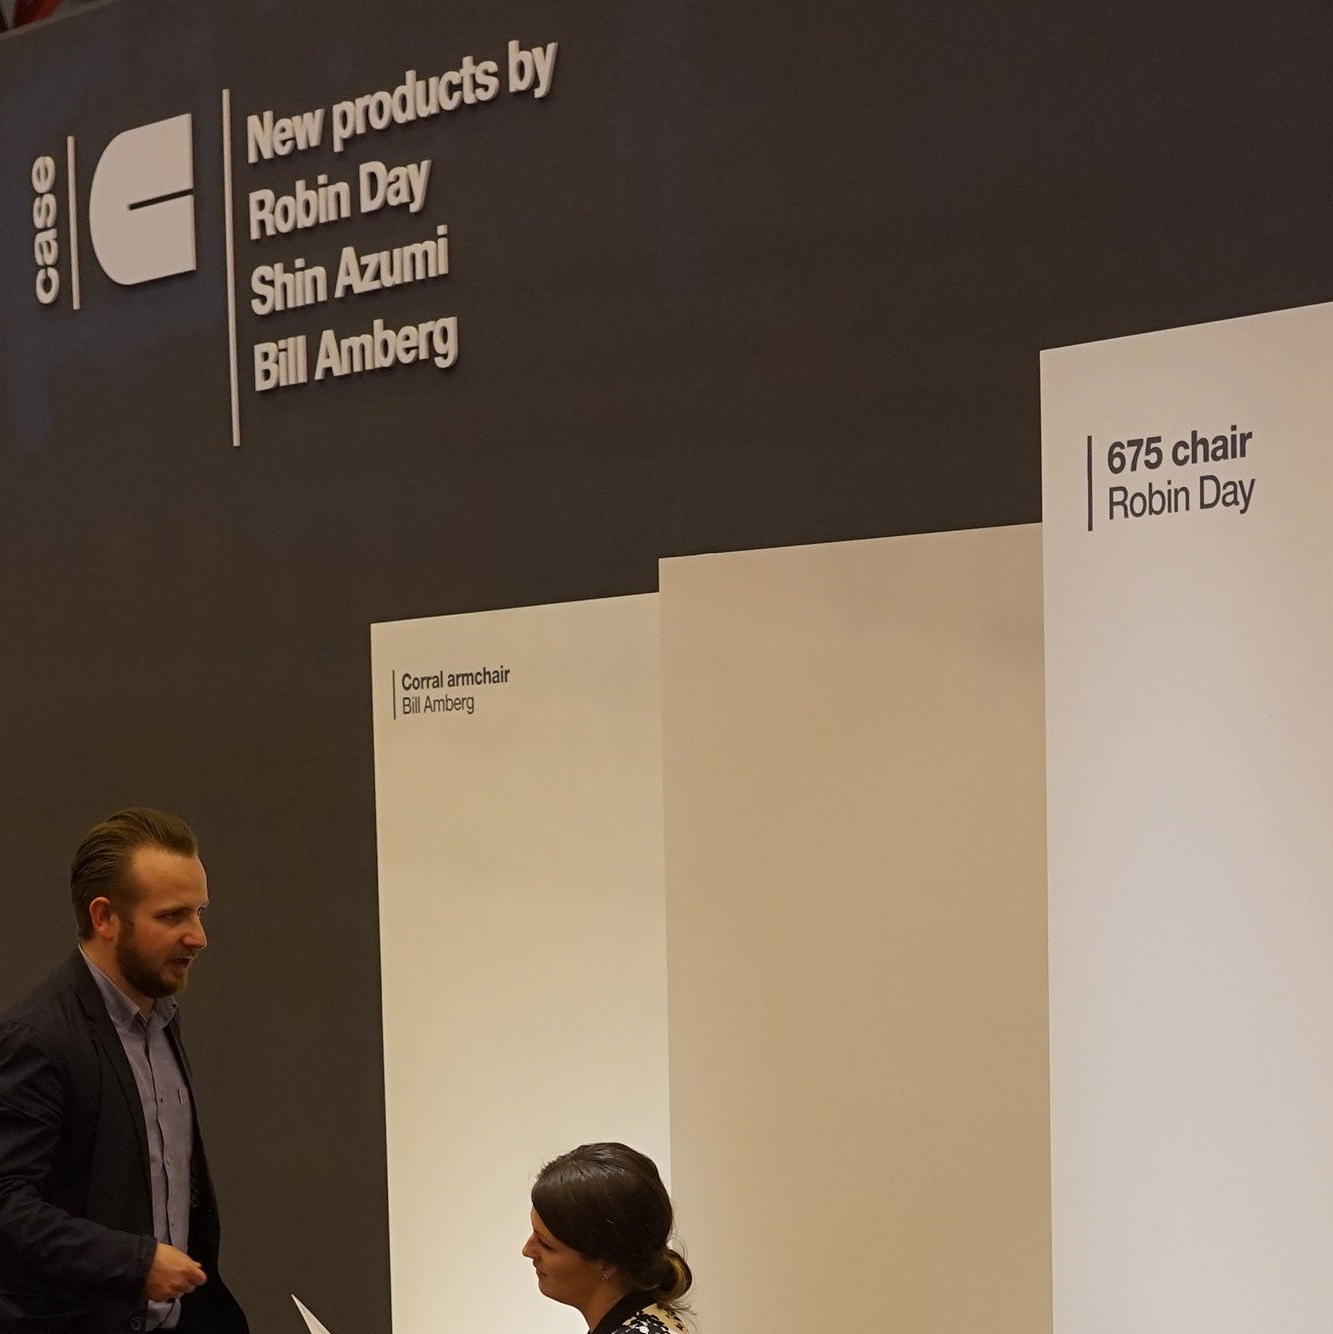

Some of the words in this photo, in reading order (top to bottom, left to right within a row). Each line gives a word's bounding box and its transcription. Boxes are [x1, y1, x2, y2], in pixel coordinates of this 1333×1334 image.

[247, 107, 324, 164] New
[332, 55, 499, 153] products
[508, 39, 559, 99] by
[31, 155, 60, 305] case
[249, 173, 351, 240] Robin
[359, 159, 432, 215] Day
[251, 257, 328, 316] Shin
[334, 224, 449, 298] Azumi
[254, 334, 308, 393] Bill
[314, 316, 459, 381] Amberg
[1107, 435, 1164, 475] 675
[1171, 424, 1254, 467] chair
[1108, 479, 1191, 520] Robin
[1199, 474, 1257, 515] Day
[401, 670, 444, 691] Corral
[447, 665, 511, 688] armchair
[402, 695, 421, 715] Bill
[423, 694, 475, 715] Amberg
